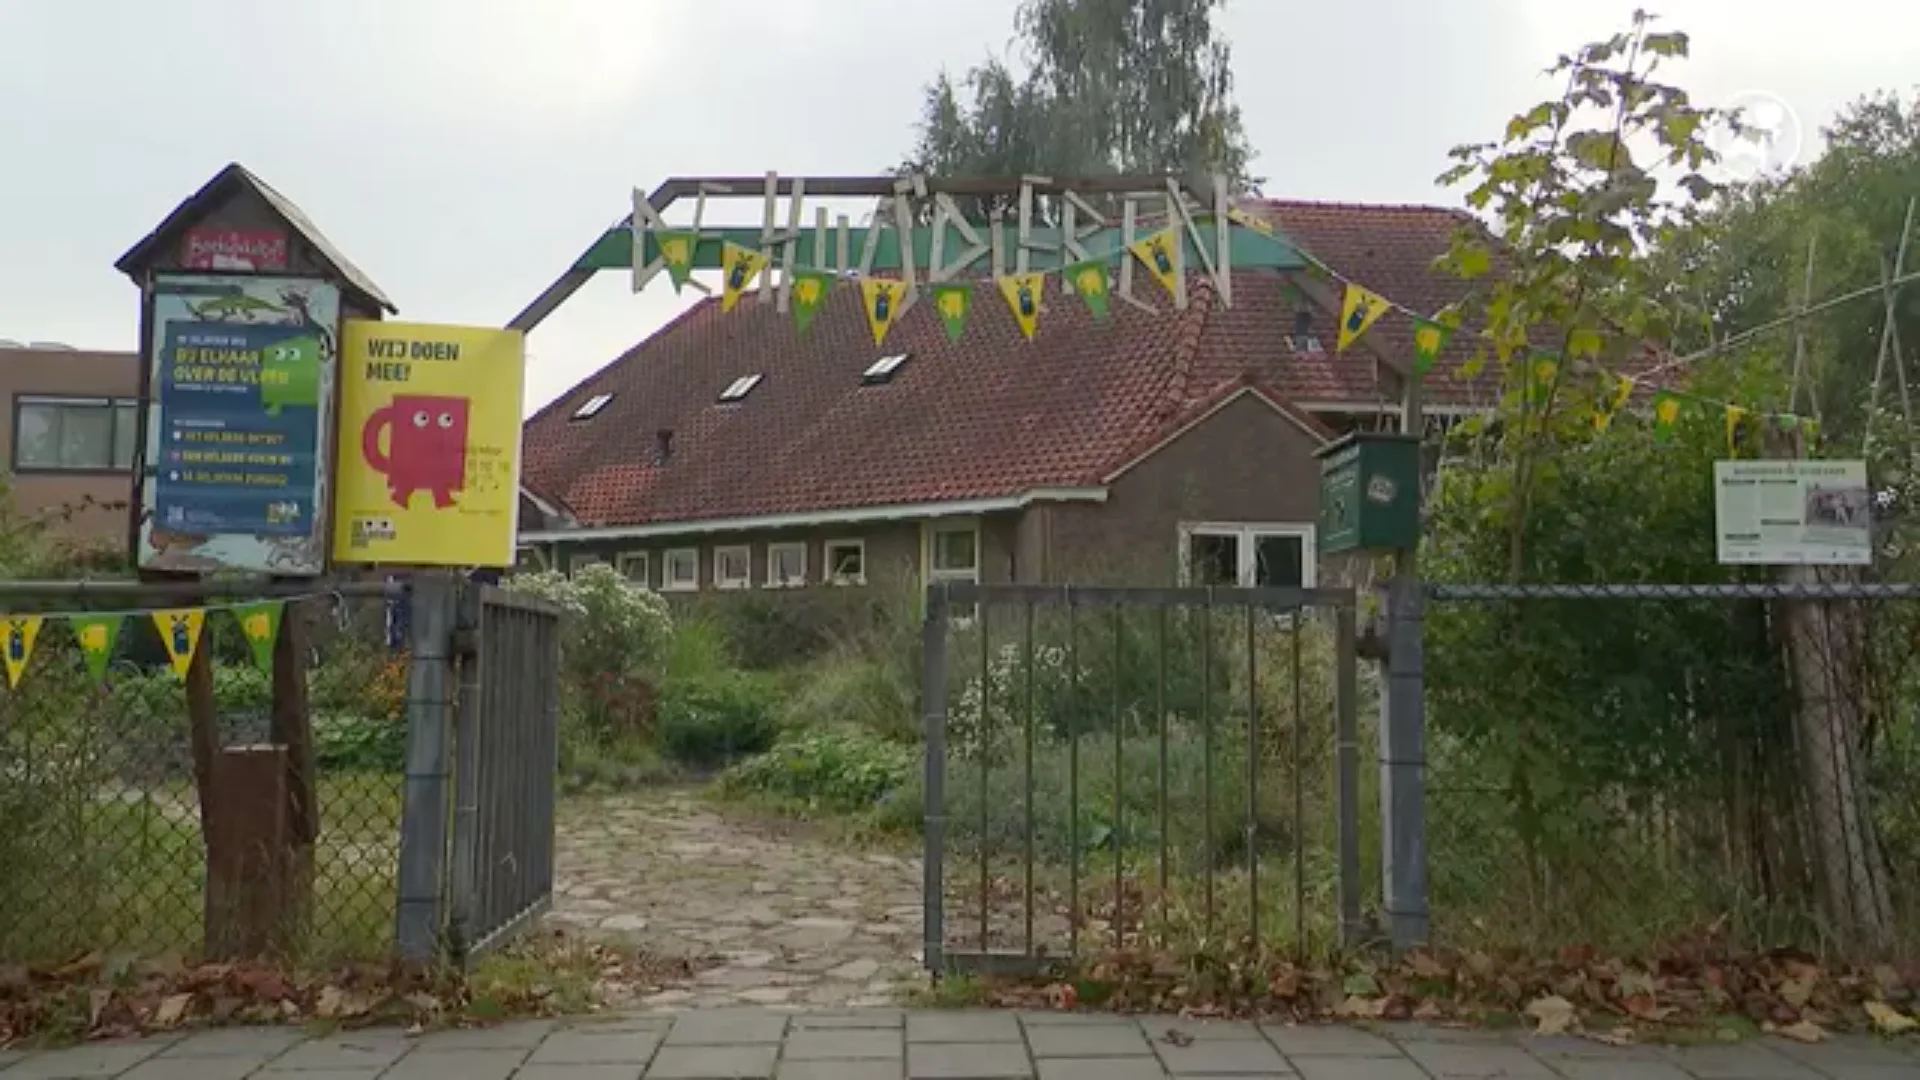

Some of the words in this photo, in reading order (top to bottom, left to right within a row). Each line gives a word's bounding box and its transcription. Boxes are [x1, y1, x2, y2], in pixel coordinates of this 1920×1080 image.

[200, 349, 260, 366] ELKAAR
[368, 338, 407, 358] WIJ
[411, 341, 460, 361] DOEN
[173, 365, 215, 383] OVER
[366, 362, 412, 381] MEE!
